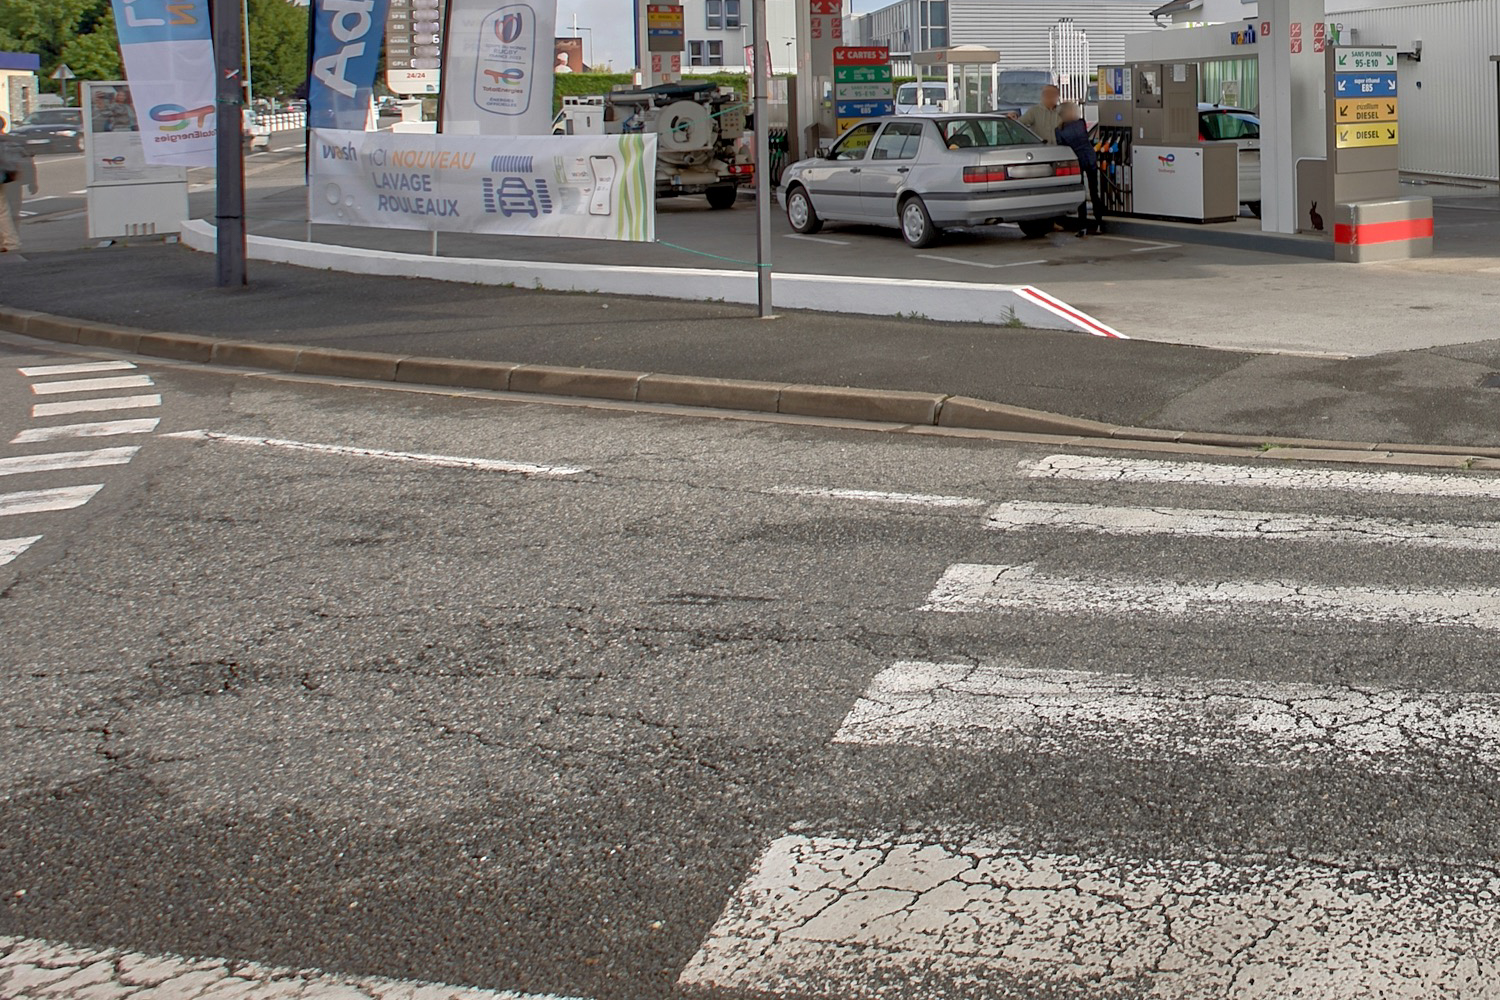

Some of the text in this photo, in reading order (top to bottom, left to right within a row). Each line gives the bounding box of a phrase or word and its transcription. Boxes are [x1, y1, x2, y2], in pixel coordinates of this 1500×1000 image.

[847, 51, 877, 59] CARTES
[1355, 59, 1379, 68] 95-E10
[1361, 84, 1374, 93] E85
[1356, 112, 1379, 120] DIESEL
[1356, 130, 1380, 140] DIESEL
[322, 140, 357, 161] wash
[369, 148, 476, 170] ICI NOUVEAU
[372, 172, 432, 192] LAVAGE
[378, 194, 460, 217] ROULEAUX
